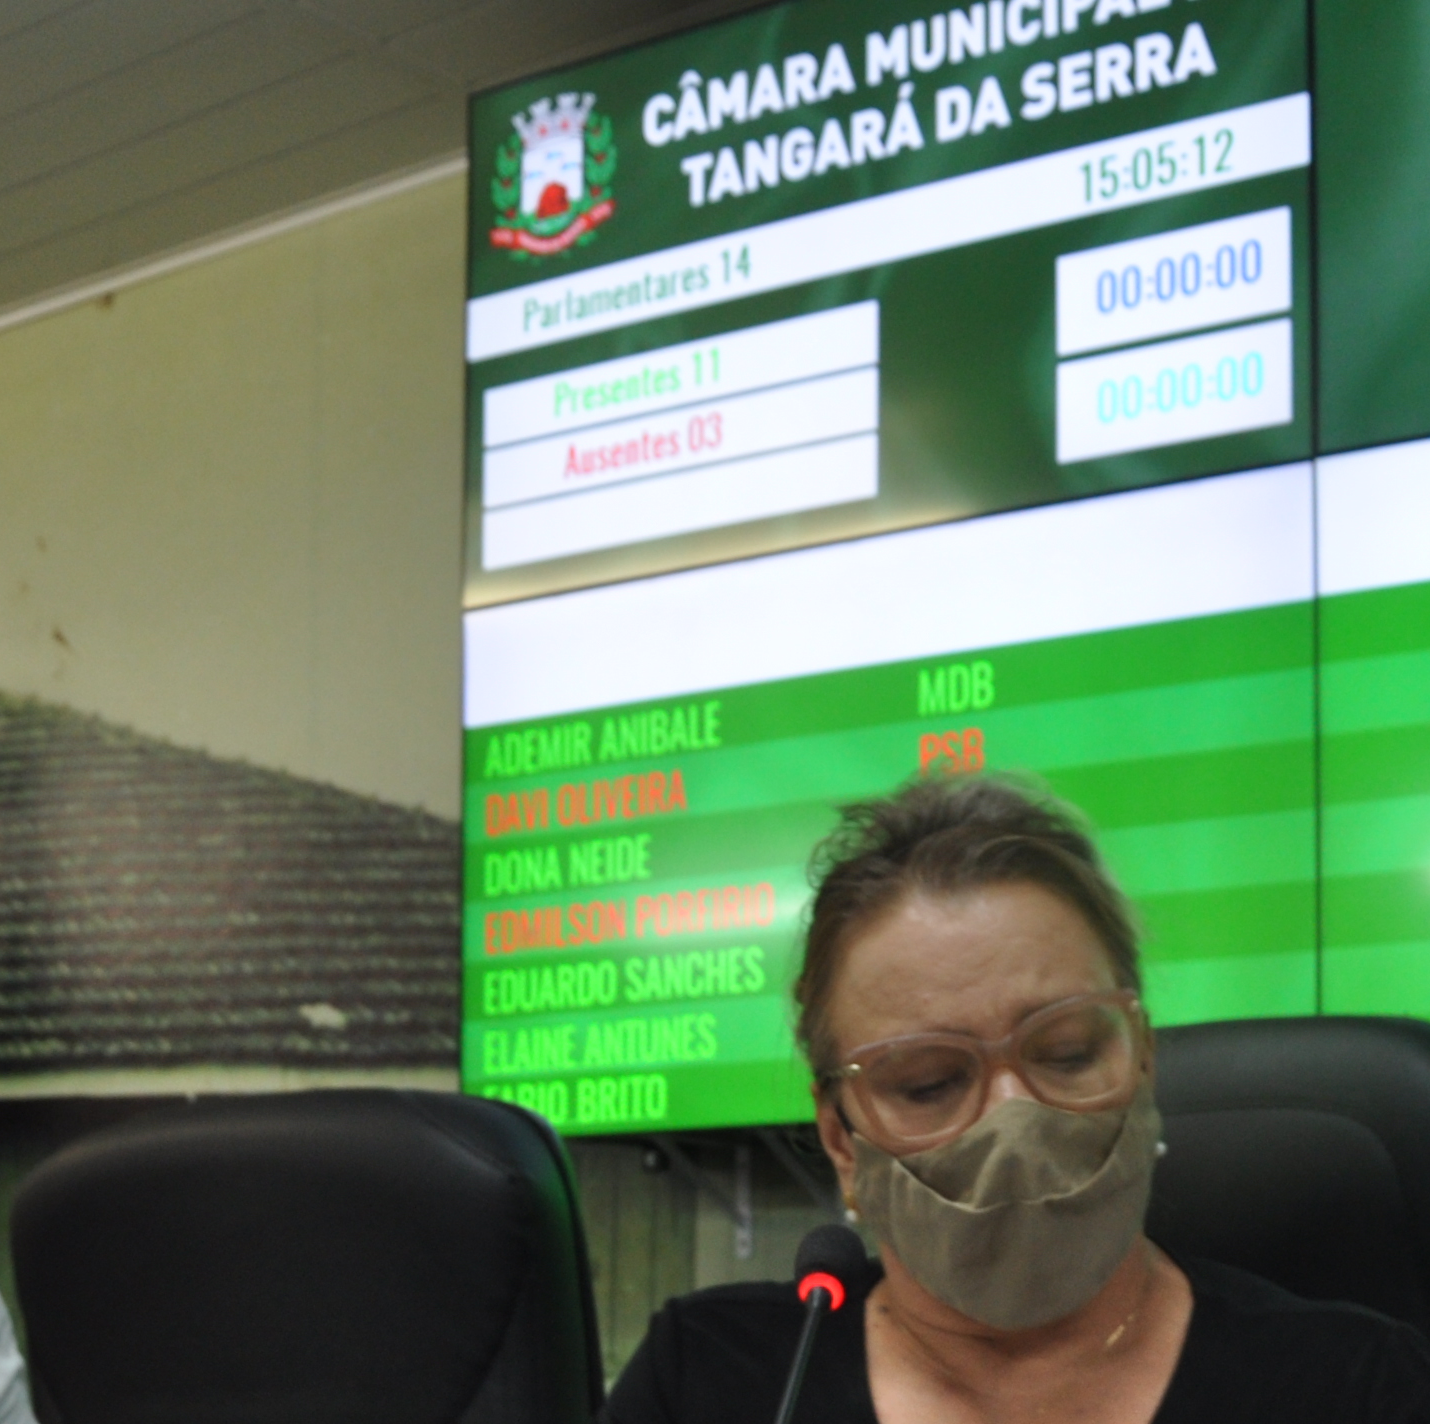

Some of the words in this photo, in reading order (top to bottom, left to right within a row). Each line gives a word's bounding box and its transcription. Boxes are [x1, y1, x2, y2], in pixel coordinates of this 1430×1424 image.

[642, 43, 856, 147] CÂMARA
[865, 0, 1189, 86] MUNICIP
[681, 81, 925, 207] TANGARÁ
[935, 76, 1012, 143] DA
[1021, 22, 1218, 121] SERRA
[1079, 128, 1236, 204] 15:05:12
[524, 263, 709, 332] Parlamentares
[721, 244, 752, 284] 14
[1096, 239, 1263, 314] 00:00:00
[554, 364, 681, 418] Presentes
[692, 347, 722, 386] 11
[1096, 351, 1265, 424] 00:00:00
[564, 431, 680, 480] Ausentes
[688, 412, 723, 452] 03
[485, 717, 594, 779] ADEMIR
[600, 701, 722, 760] ANIBALE
[918, 659, 995, 715] MDB
[485, 784, 552, 838] DAVI
[558, 768, 687, 827] OLIVEIRA
[484, 846, 562, 897] DONA
[568, 834, 652, 885] NEIDE
[484, 894, 627, 957] EDMILSON
[635, 882, 776, 936] PORFIRIO
[484, 963, 618, 1016] EDUARDO
[625, 946, 765, 997] SANCHES
[484, 1024, 576, 1076] ELAINE
[583, 1012, 718, 1069] ANTUNES
[576, 1073, 668, 1124] BRITO
